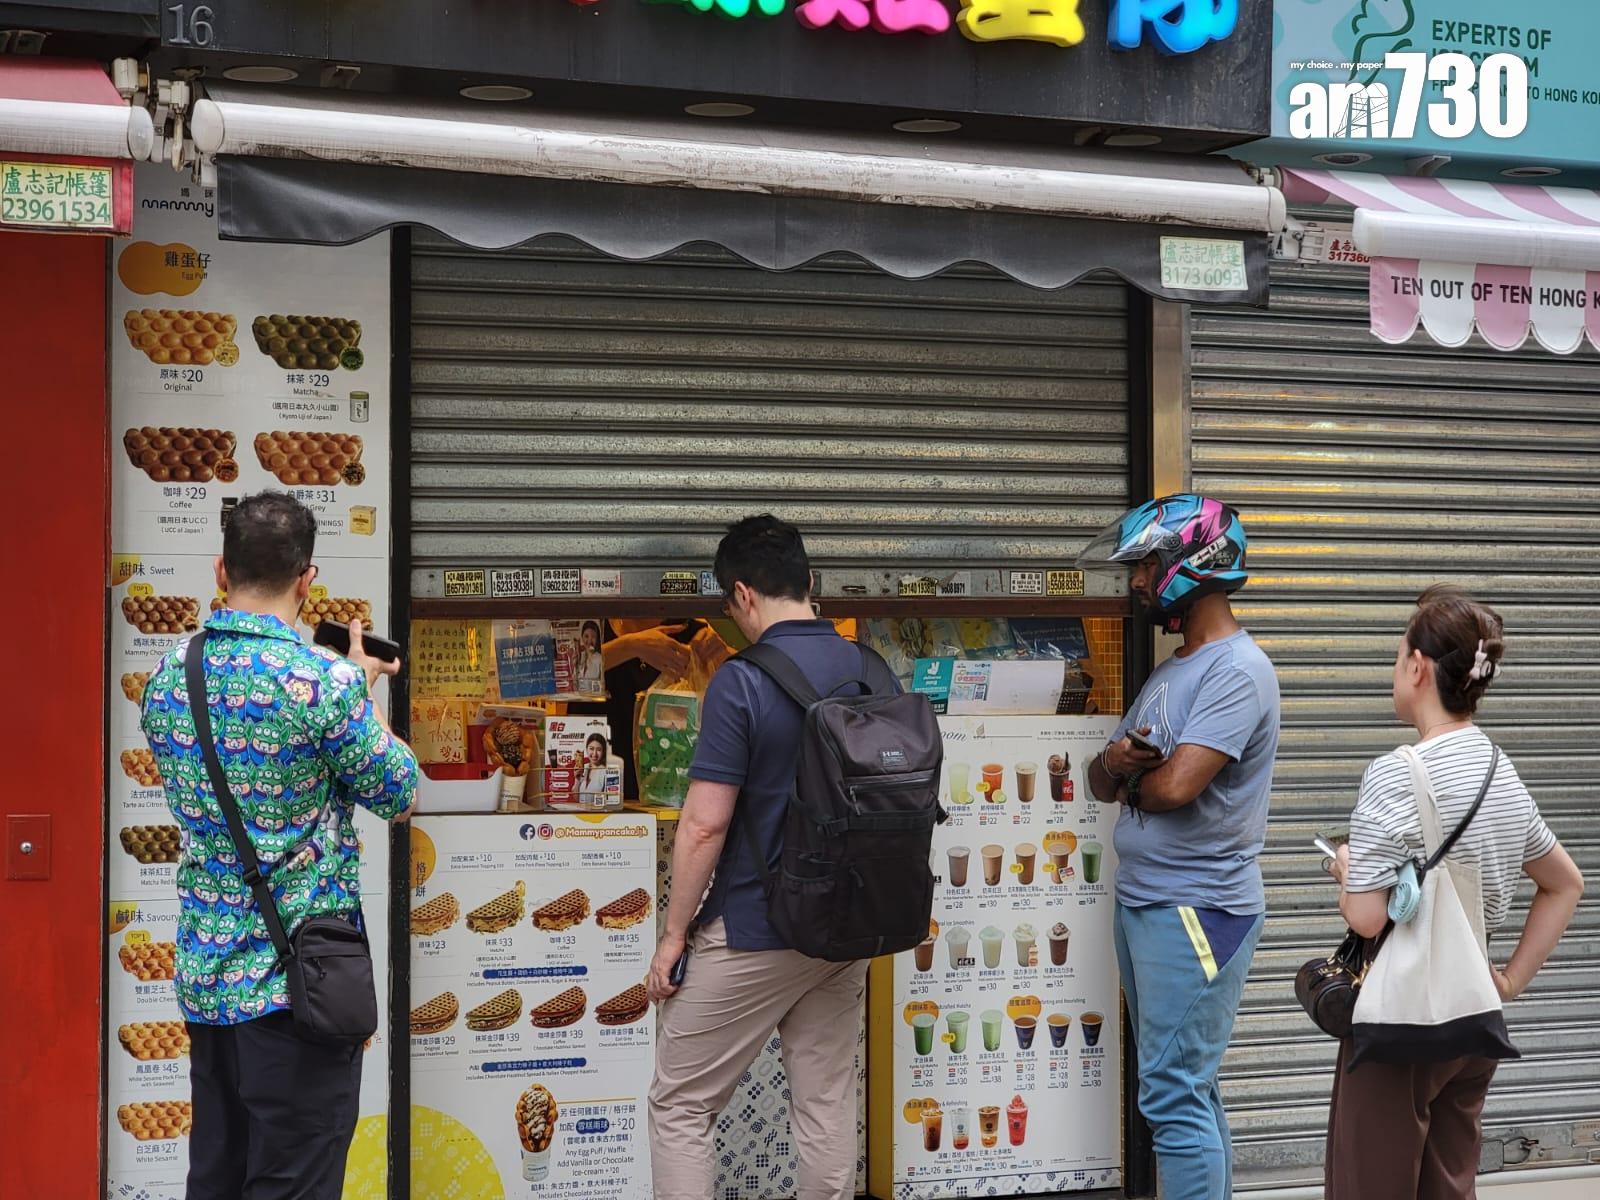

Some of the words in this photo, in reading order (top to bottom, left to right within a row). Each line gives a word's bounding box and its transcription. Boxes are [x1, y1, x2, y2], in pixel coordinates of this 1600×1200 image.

[168, 4, 214, 46] 16
[1432, 19, 1520, 47] EXPERTS
[1527, 29, 1552, 50] OF
[1545, 88, 1577, 103] HONG
[2, 167, 110, 199] 盧志記帳篷
[1163, 240, 1242, 267] 盧志記帳篷
[165, 251, 211, 269] 雞蛋仔
[1391, 276, 1424, 296] TEN
[1430, 280, 1464, 299] OUT
[1471, 282, 1495, 301] OF
[1500, 284, 1532, 304] TEN
[1539, 288, 1587, 307] HONG
[160, 369, 179, 380] 原味
[182, 369, 203, 383] $20
[287, 374, 304, 384] 抹茶
[309, 374, 330, 388] $29
[164, 383, 192, 393] Original
[293, 387, 319, 397] Matcha
[163, 487, 182, 498] 咖啡
[185, 487, 207, 500] $29
[316, 490, 337, 503] $31
[169, 501, 193, 510] Coffee
[119, 562, 145, 577] 甜味
[150, 566, 175, 576] Sweet
[116, 909, 144, 924] 鹹味
[147, 912, 178, 924] Savoury
[499, 938, 513, 947] $33
[563, 936, 576, 945] $33
[626, 934, 640, 943] $35
[432, 940, 447, 950] $23
[570, 1029, 584, 1039] $39
[636, 1027, 649, 1035] $41
[441, 1035, 456, 1045] $29
[506, 1033, 520, 1042] $39
[162, 1063, 179, 1073] $45
[559, 1122, 575, 1132] 加配
[617, 1117, 635, 1131] $20
[136, 1145, 160, 1155] 白芝麻
[161, 1143, 178, 1154] $27
[565, 1150, 577, 1158] Any
[578, 1149, 590, 1157] Egg
[570, 1159, 593, 1167] Vanilla
[602, 1156, 634, 1165] Chocolate
[563, 1190, 593, 1198] Chocolate
[593, 1188, 611, 1196] Sauce
